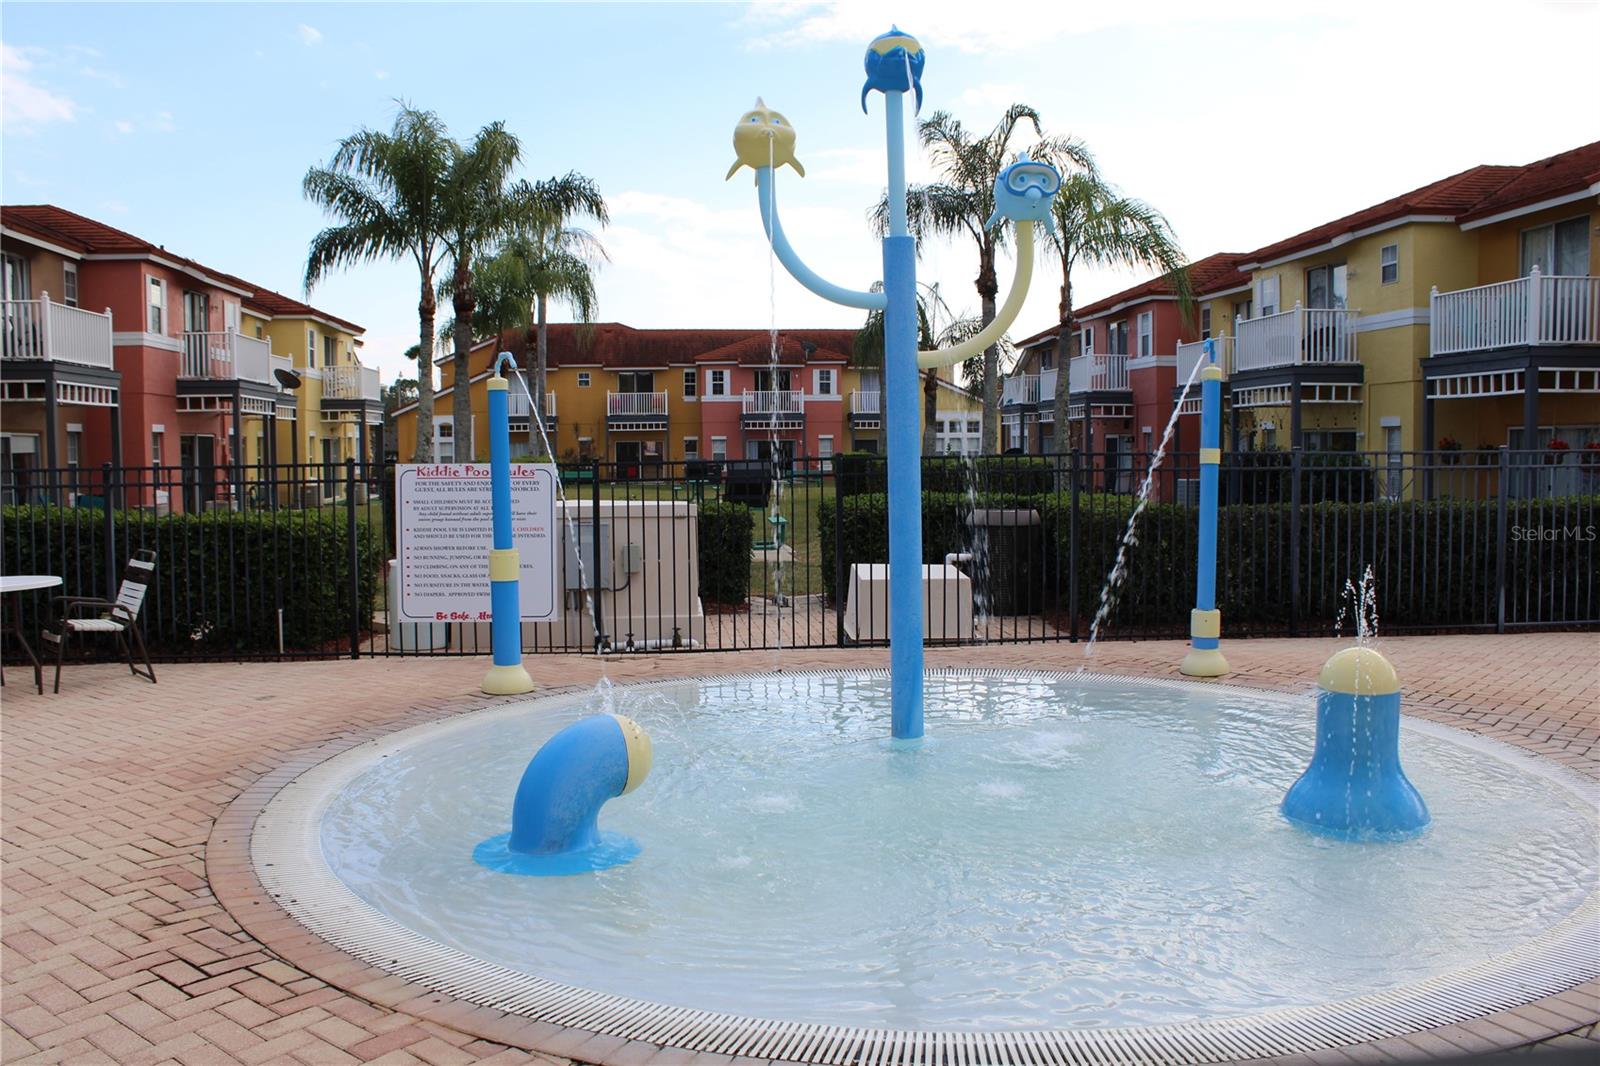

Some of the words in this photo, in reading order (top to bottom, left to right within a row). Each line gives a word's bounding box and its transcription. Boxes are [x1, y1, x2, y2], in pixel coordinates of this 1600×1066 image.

[416, 465, 460, 477] Kiddie
[465, 465, 490, 477] Poo
[510, 465, 535, 477] ules
[436, 612, 448, 620] Be
